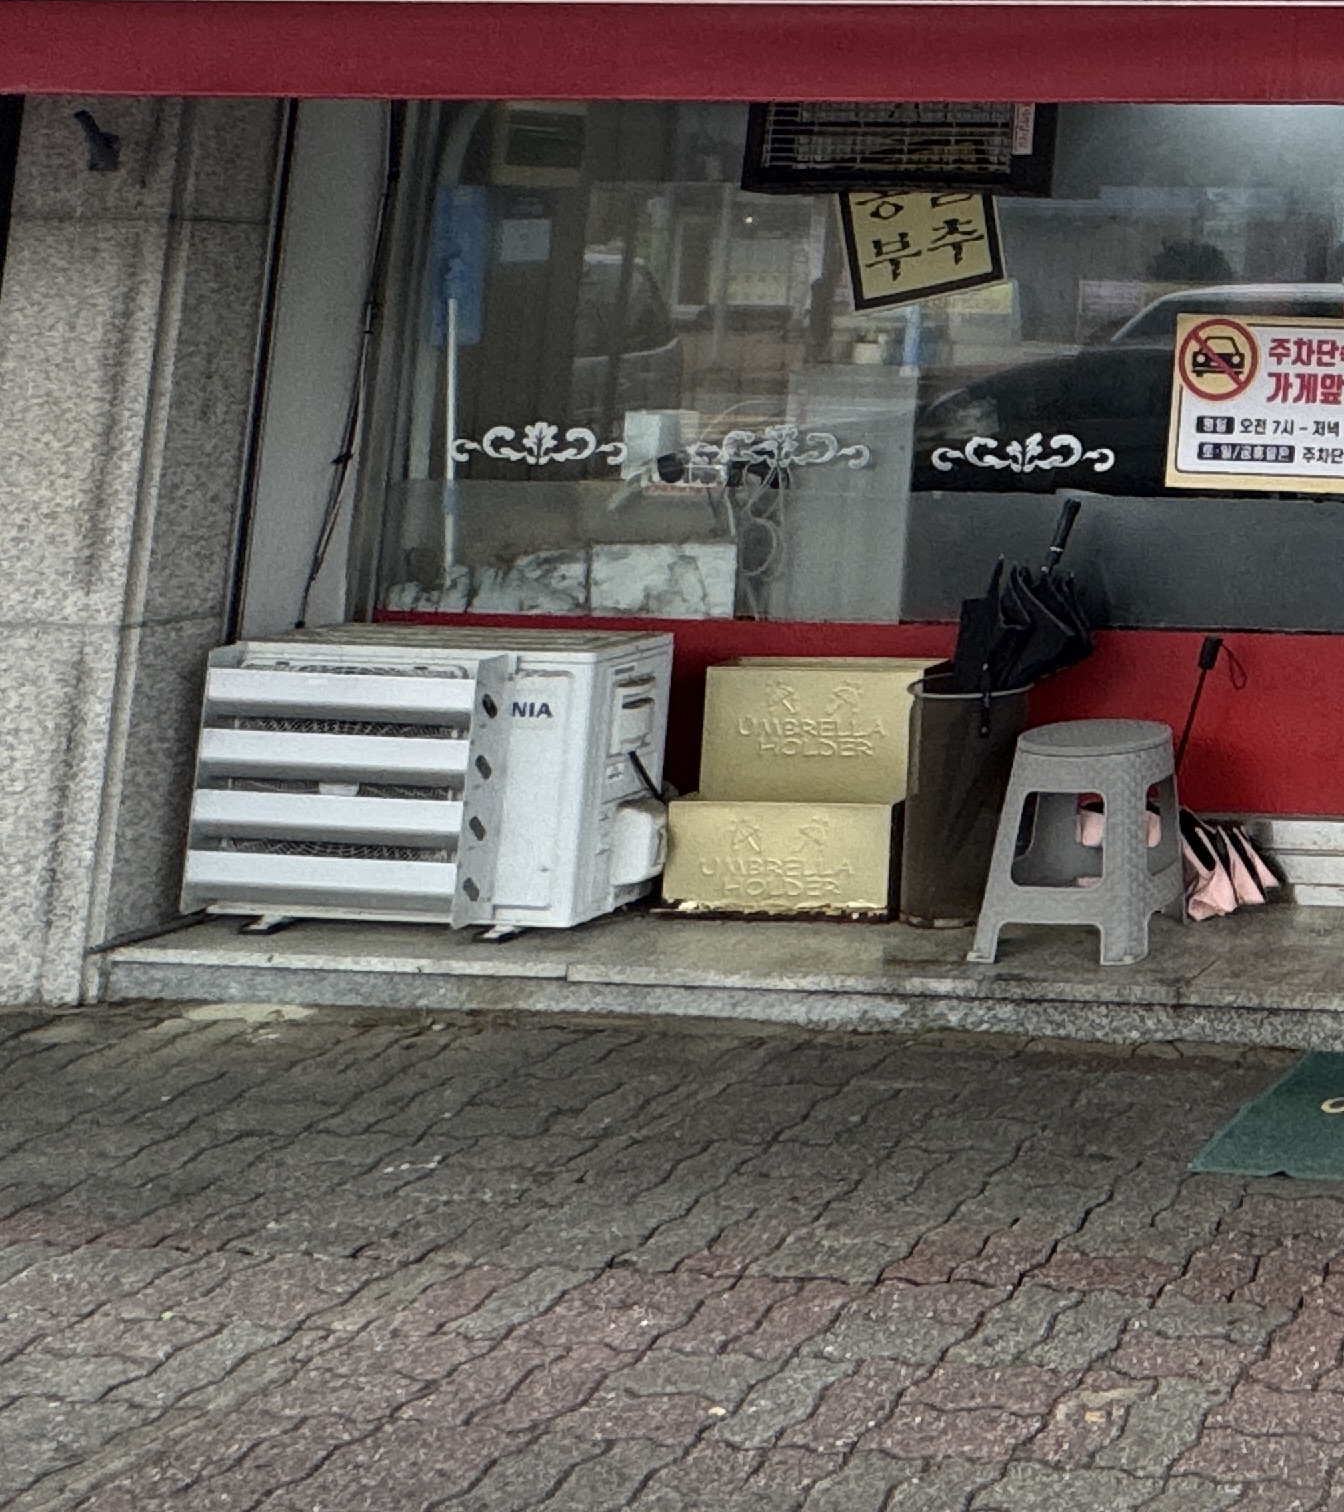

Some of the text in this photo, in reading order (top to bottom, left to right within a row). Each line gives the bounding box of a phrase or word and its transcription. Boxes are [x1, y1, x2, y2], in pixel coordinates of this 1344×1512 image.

[864, 218, 985, 282] 부추
[1239, 418, 1267, 435] 오전
[1272, 419, 1295, 436] 7시
[1312, 420, 1340, 437] 저녁
[738, 716, 886, 738] UMBRELLA
[758, 736, 876, 758] HOLDER
[701, 854, 855, 878] UMBRELLA
[724, 874, 844, 898] HOLDER
